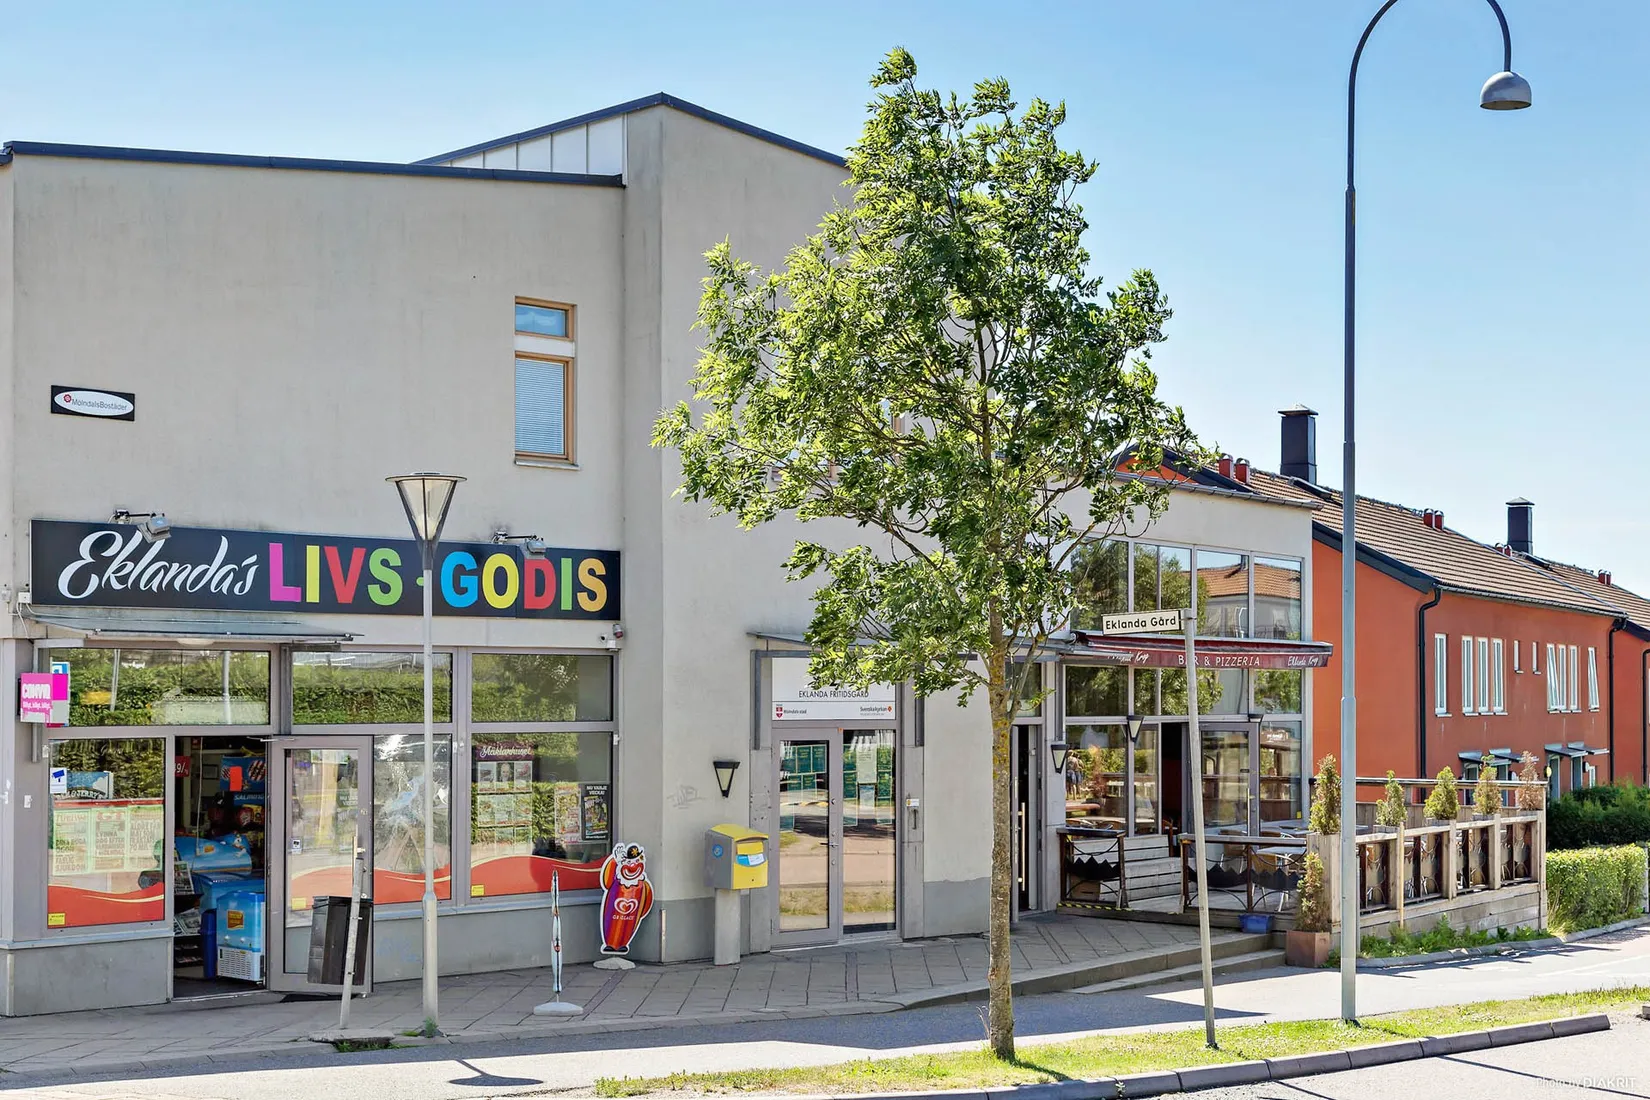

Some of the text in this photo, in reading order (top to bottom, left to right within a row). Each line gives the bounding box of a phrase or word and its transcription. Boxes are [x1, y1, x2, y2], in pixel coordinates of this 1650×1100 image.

[58, 530, 608, 612] Eklanda's LIVS GODIS
[1105, 615, 1176, 630] Eklanda Gård
[1178, 654, 1260, 667] BR & PIZZERIA
[798, 690, 828, 698] EKLANDA
